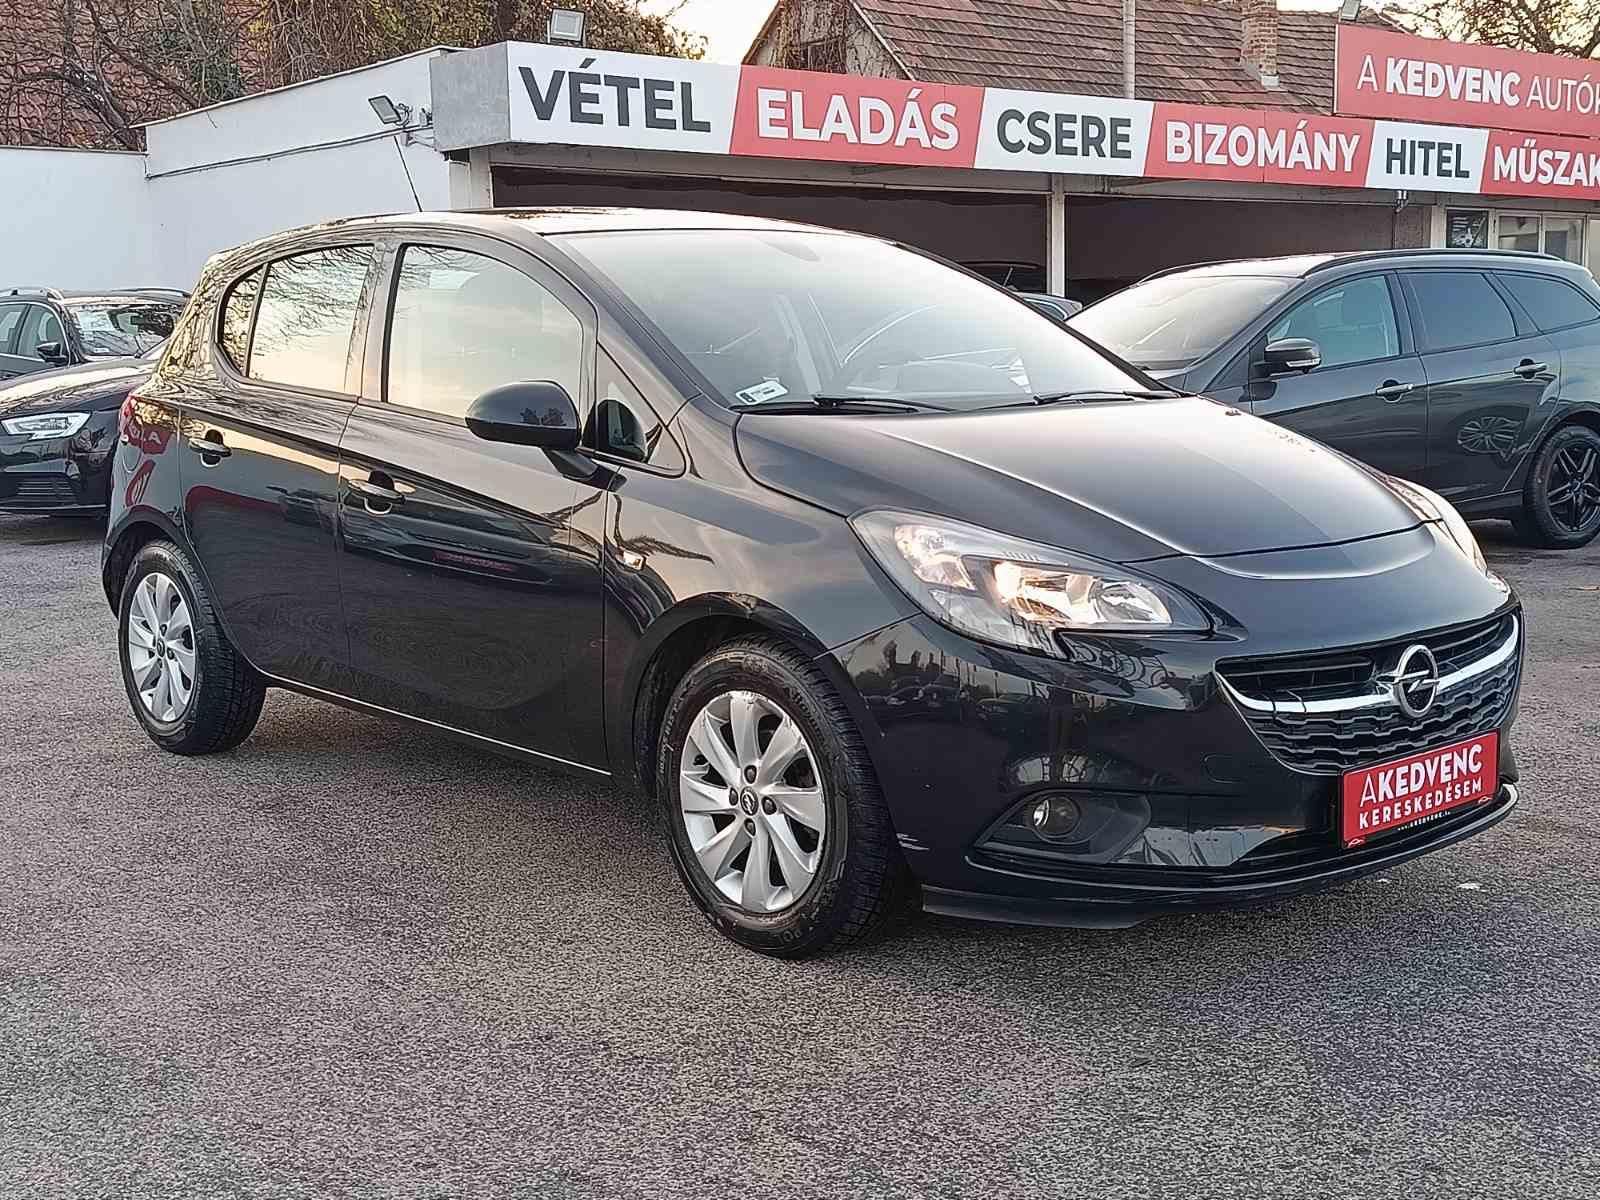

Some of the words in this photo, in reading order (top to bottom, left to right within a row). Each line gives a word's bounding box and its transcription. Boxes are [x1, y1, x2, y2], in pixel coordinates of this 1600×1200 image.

[519, 58, 711, 133] VÉTEL
[1357, 55, 1379, 91] A
[1386, 57, 1521, 106] KEDVENC
[1526, 74, 1600, 115] AUTÓ
[757, 88, 959, 149] ELADÁS
[997, 109, 1132, 159] CSERE
[1166, 120, 1360, 172] BIZOMÁNY
[1386, 138, 1470, 178] HITEL
[1359, 777, 1482, 829] KERESKEDÉSEM
